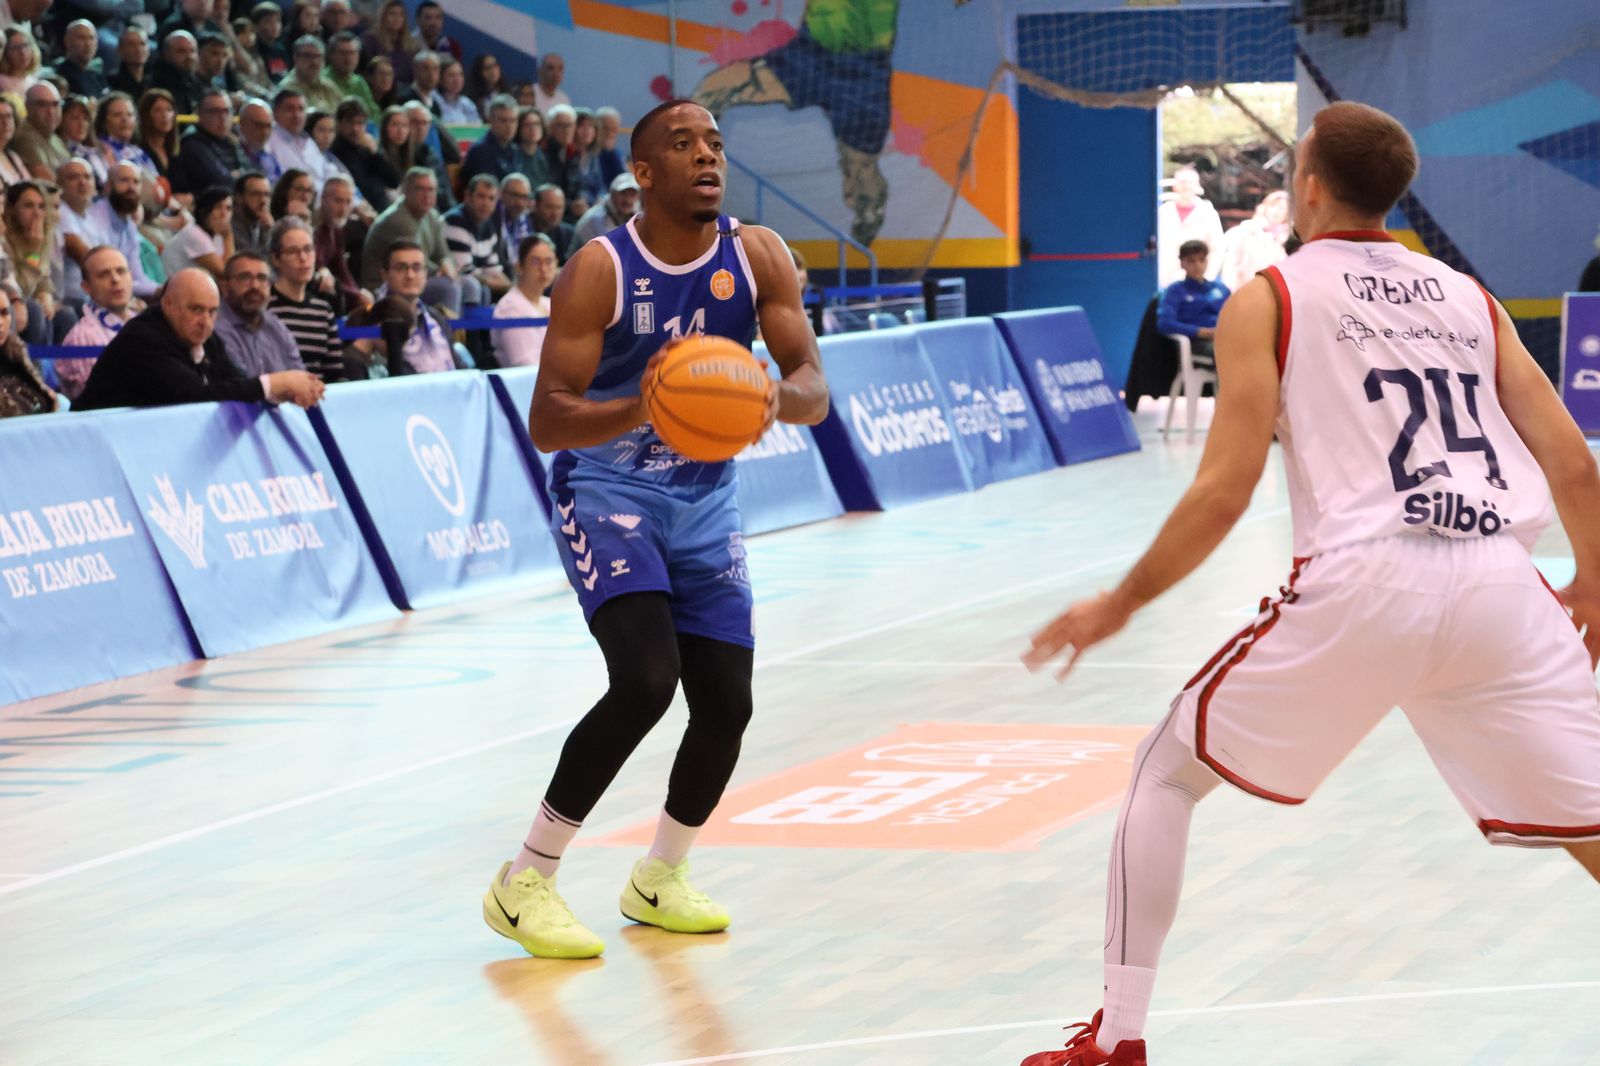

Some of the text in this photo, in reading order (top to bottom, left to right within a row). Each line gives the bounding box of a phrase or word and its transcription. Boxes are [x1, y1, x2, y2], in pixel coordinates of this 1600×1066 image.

[1343, 272, 1445, 304] CREMO
[1363, 367, 1509, 493] 24
[206, 471, 338, 523] CAJA RURAL
[0, 496, 135, 556] AJA RURAL
[225, 521, 325, 560] DE ZAMORA
[2, 552, 117, 599] DE ZAMORA
